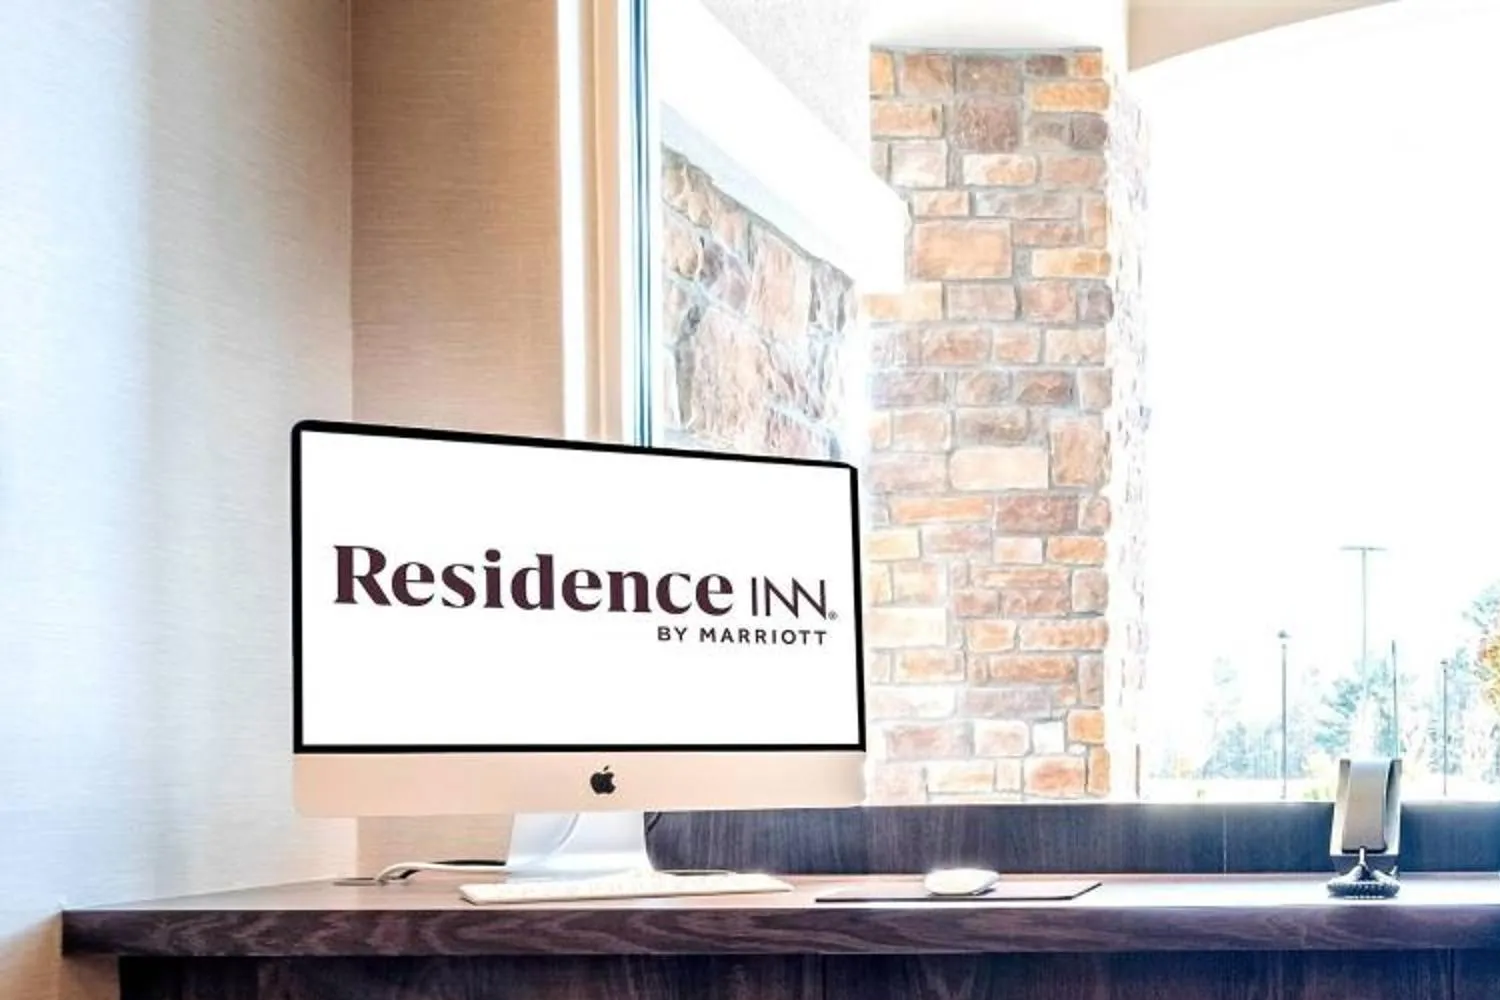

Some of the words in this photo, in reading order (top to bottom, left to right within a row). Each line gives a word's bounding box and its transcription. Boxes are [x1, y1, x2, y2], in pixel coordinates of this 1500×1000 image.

[333, 544, 734, 617] Residence
[657, 625, 688, 643] BY
[699, 627, 827, 646] MARRIOTT
